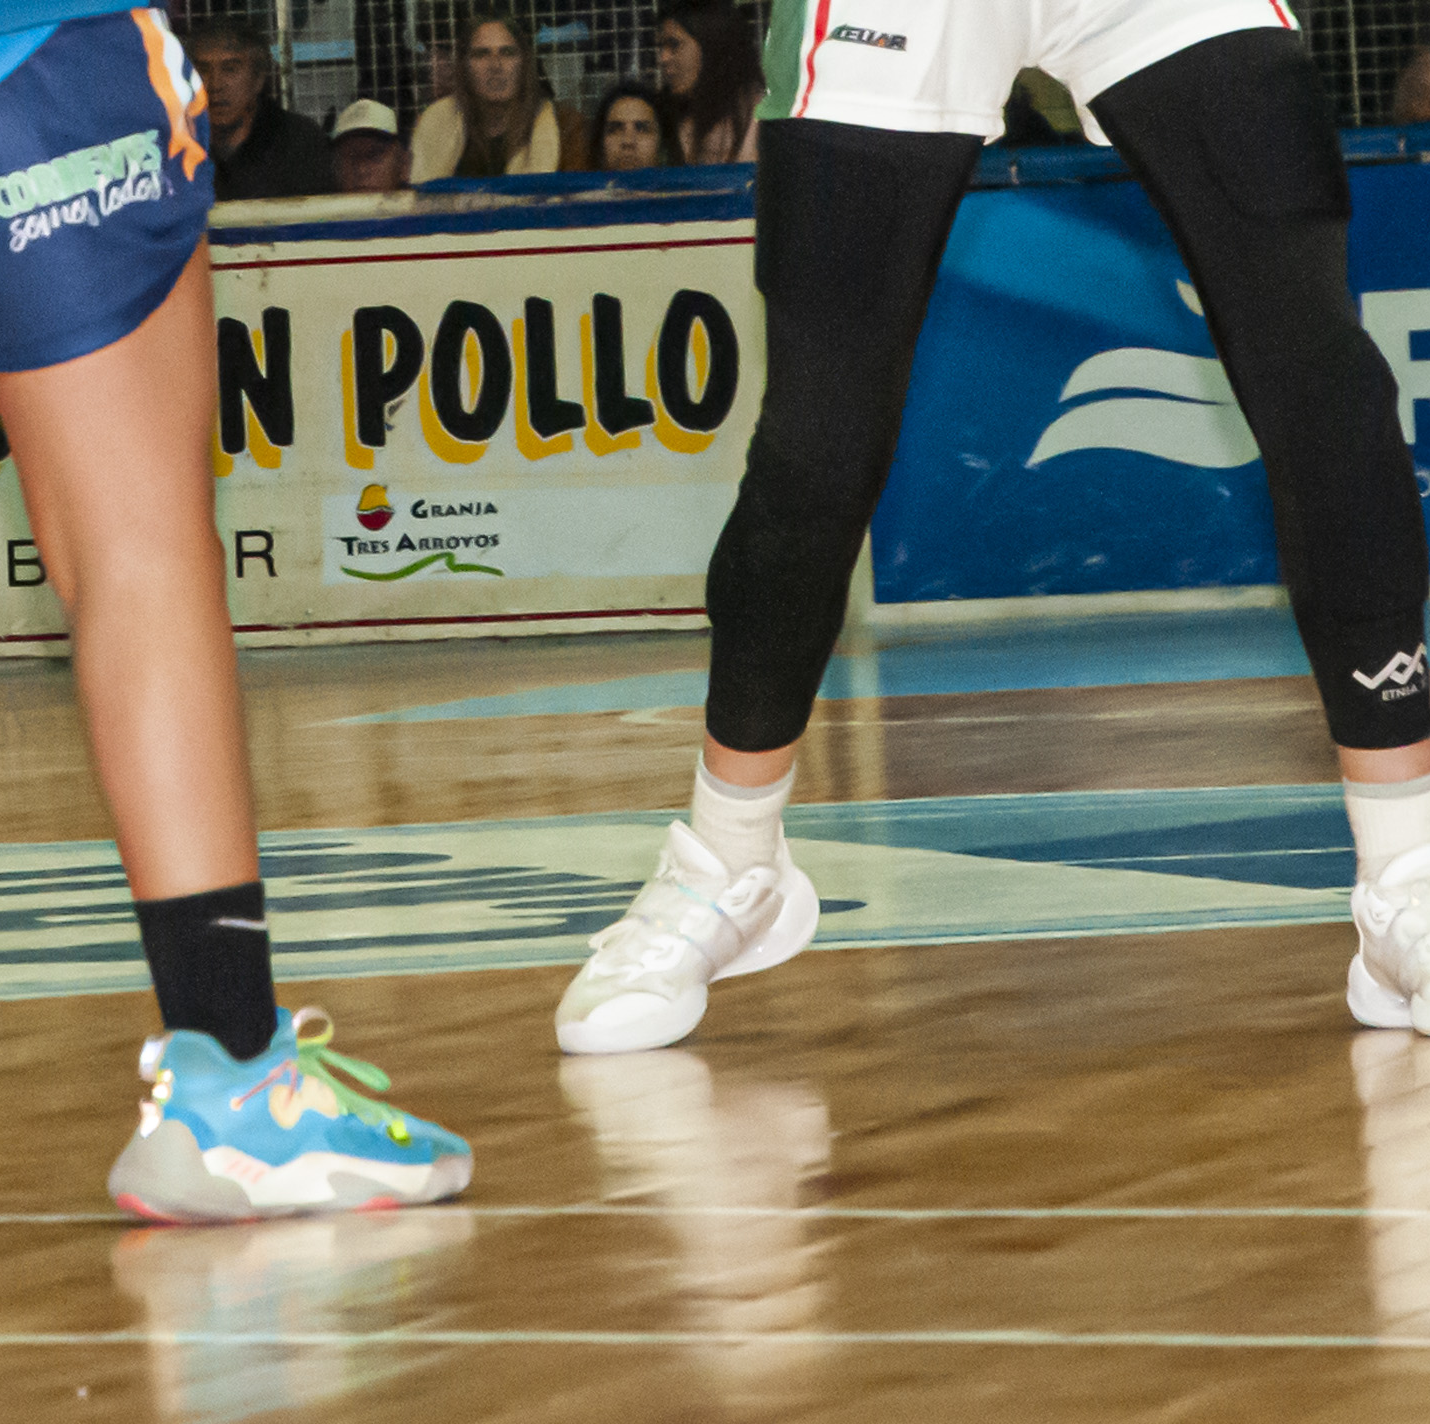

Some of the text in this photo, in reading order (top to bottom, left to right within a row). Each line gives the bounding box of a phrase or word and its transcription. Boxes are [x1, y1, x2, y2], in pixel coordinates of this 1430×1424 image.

[351, 289, 740, 448] POLLO
[411, 499, 498, 519] GRANJA
[333, 533, 500, 556] TRES ARROYOS
